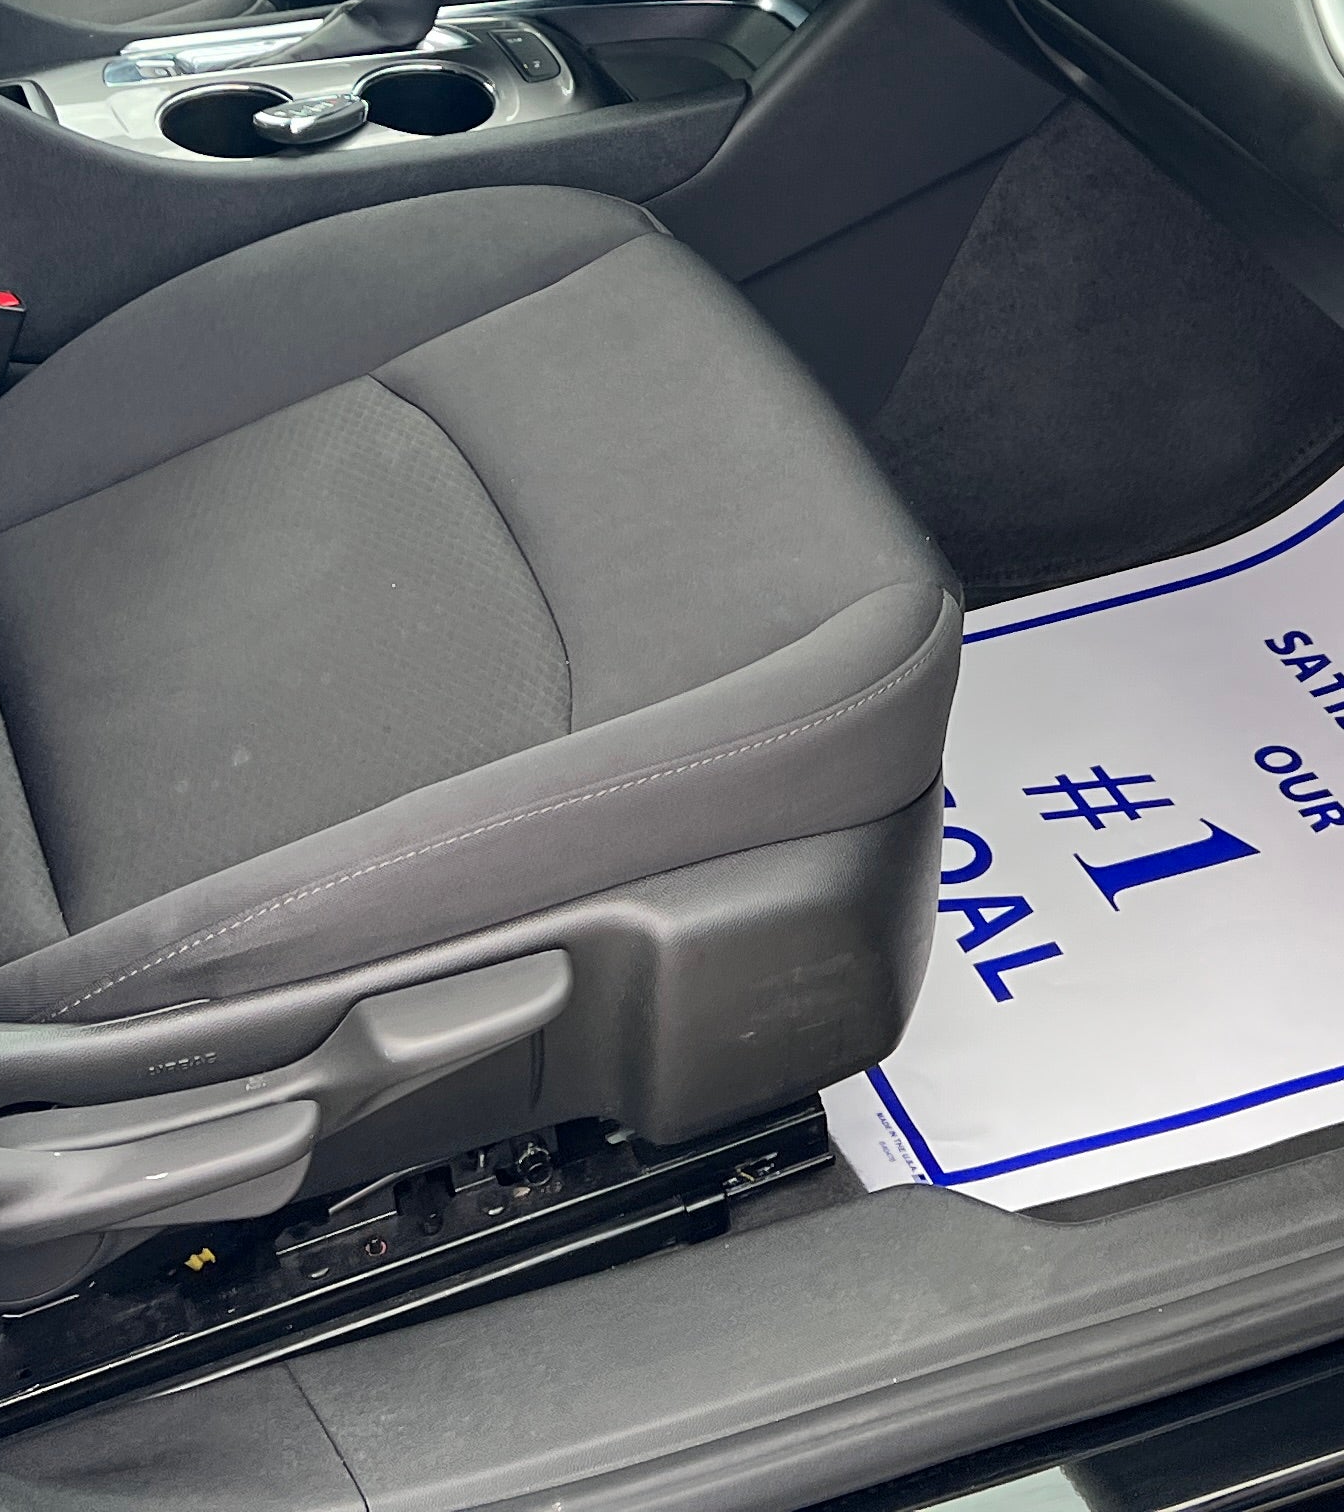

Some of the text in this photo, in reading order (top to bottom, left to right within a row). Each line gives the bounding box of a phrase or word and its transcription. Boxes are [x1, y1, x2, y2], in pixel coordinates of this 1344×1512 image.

[937, 785, 1064, 1004] OAL
[1021, 763, 1260, 911] #1
[876, 1111, 892, 1131] MADE
